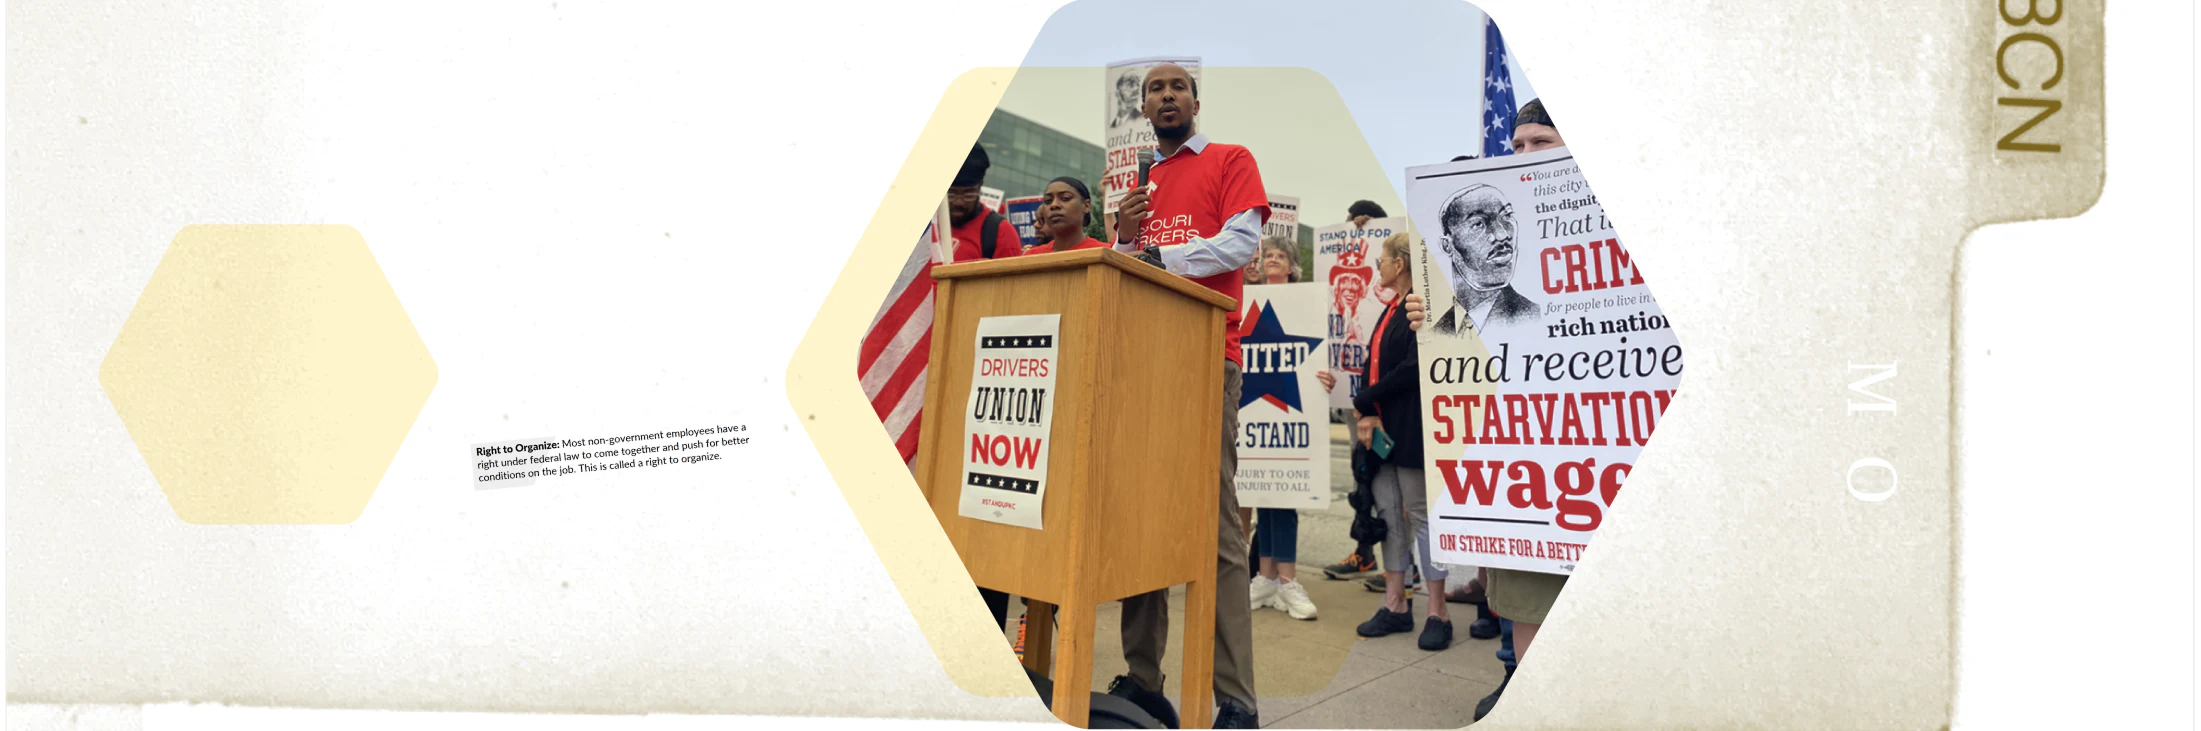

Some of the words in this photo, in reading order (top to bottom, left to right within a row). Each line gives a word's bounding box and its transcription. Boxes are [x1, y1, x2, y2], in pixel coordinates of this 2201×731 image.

[1107, 128, 1133, 149] and
[1553, 166, 1571, 178] are
[1534, 184, 1557, 197] this
[1560, 180, 1582, 194] city
[1535, 202, 1557, 214] the
[1559, 194, 1601, 210] dignit
[1320, 230, 1348, 242] STAND
[1350, 228, 1364, 239] UP
[1367, 228, 1392, 238] FOR
[1536, 212, 1594, 240] That
[1320, 242, 1362, 255] AMERICA
[1422, 264, 1430, 288] Luther
[1424, 288, 1432, 310] Martin
[1544, 302, 1563, 316] for
[1564, 298, 1601, 314] people
[1604, 296, 1614, 308] to
[1616, 293, 1636, 307] live
[1639, 292, 1650, 304] in
[1547, 316, 1596, 338] rich
[1328, 343, 1370, 368] VER
[1429, 342, 1511, 384] and
[1522, 336, 1684, 382] receive
[980, 358, 1049, 378] DRIVERS
[974, 387, 1046, 426] UNION
[1246, 422, 1310, 448] STAND
[970, 432, 1042, 470] NOW
[1269, 470, 1284, 479] TO
[1286, 470, 1310, 479] ONE
[1237, 482, 1272, 491] INJURY
[1275, 482, 1289, 492] TO
[1291, 482, 1310, 492] ALL
[1439, 534, 1457, 551] ON
[1459, 534, 1507, 556] STRIKE
[1508, 538, 1534, 558] FOR
[1536, 540, 1546, 558] A
